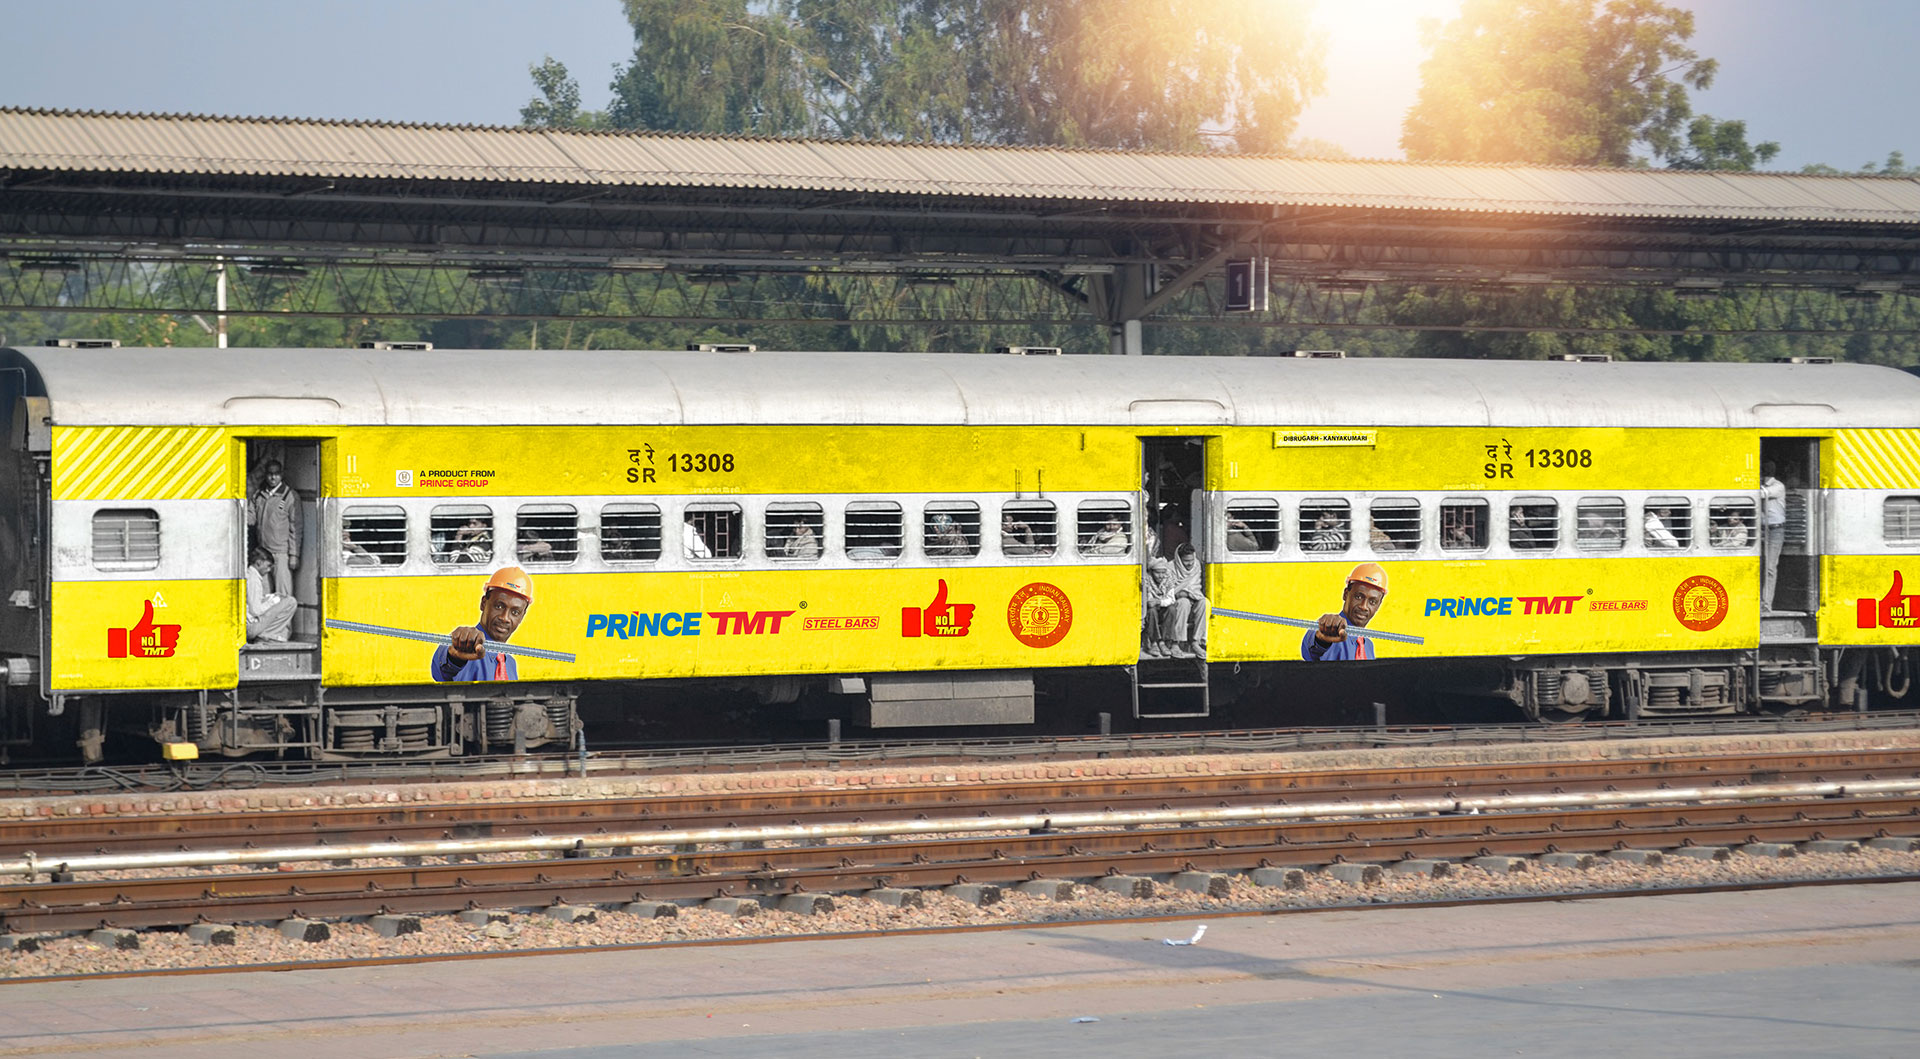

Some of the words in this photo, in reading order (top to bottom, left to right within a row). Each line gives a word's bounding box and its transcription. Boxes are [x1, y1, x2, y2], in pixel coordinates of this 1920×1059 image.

[1236, 272, 1243, 297] 1
[668, 453, 735, 473] 13308
[1525, 448, 1593, 468] 13308
[419, 470, 426, 478] A
[429, 470, 467, 478] PRODUCT
[470, 470, 496, 478] FROM
[419, 479, 454, 488] PRINCE
[456, 479, 489, 488] GROUP
[1039, 585, 1061, 598] INDIAN
[1059, 595, 1070, 623] RAILWAY
[1424, 596, 1513, 619] PRINCE
[1591, 602, 1619, 610] STEEL
[1621, 601, 1646, 609] BARS
[586, 611, 702, 640] PRINCE
[805, 618, 842, 630] STEEL
[844, 617, 878, 629] BARS
[1890, 617, 1919, 626] TMT
[935, 626, 963, 635] TMT
[141, 647, 169, 656] TMT
